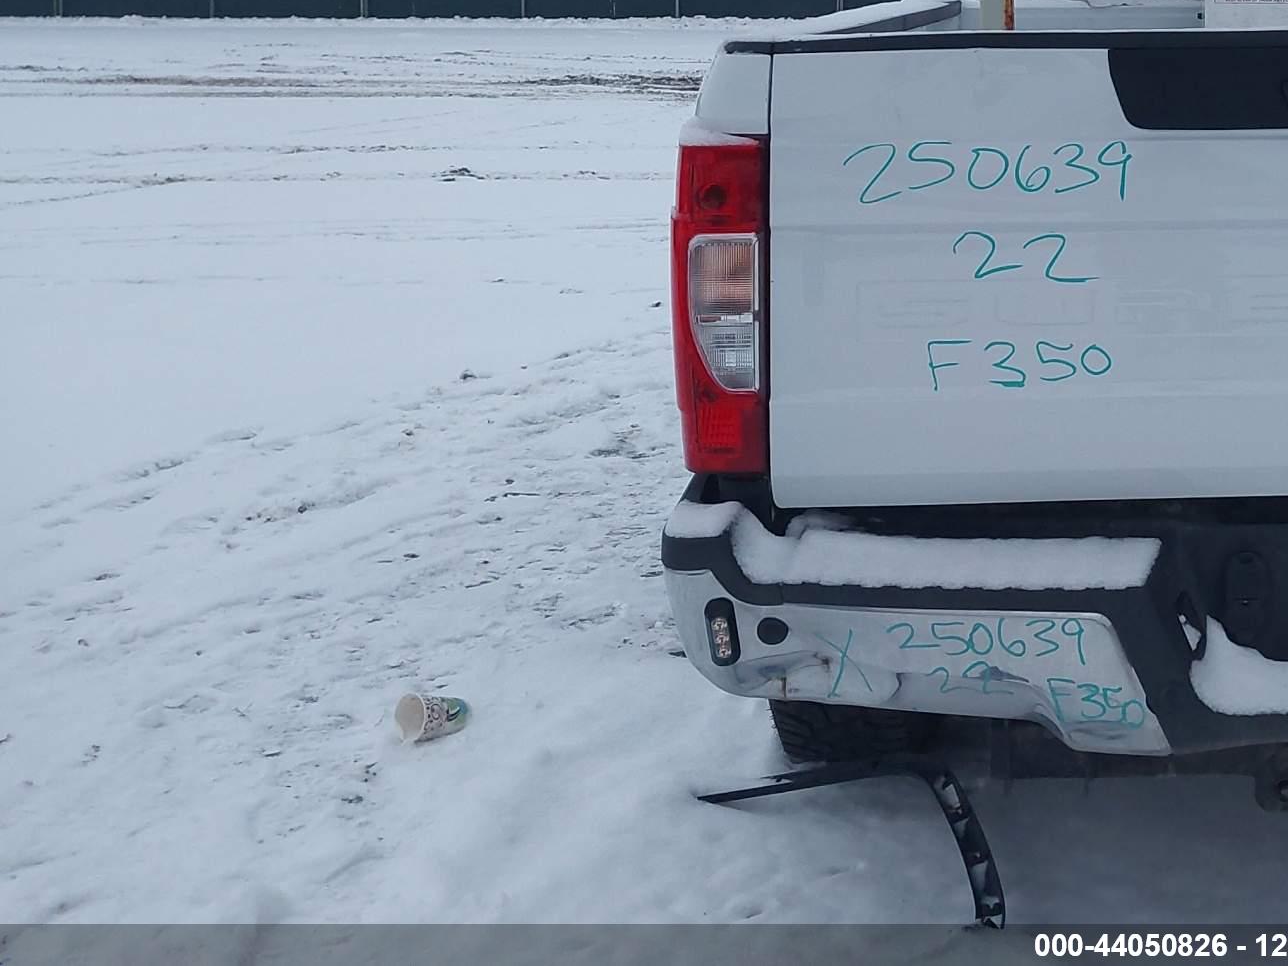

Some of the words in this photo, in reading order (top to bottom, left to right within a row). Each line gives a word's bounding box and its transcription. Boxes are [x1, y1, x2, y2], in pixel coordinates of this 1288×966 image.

[842, 140, 1133, 204] 250639
[952, 230, 1099, 283] 22
[926, 339, 1114, 391] F350
[886, 617, 1087, 666] 250639
[927, 660, 1014, 695] 22
[1046, 677, 1146, 729] F350
